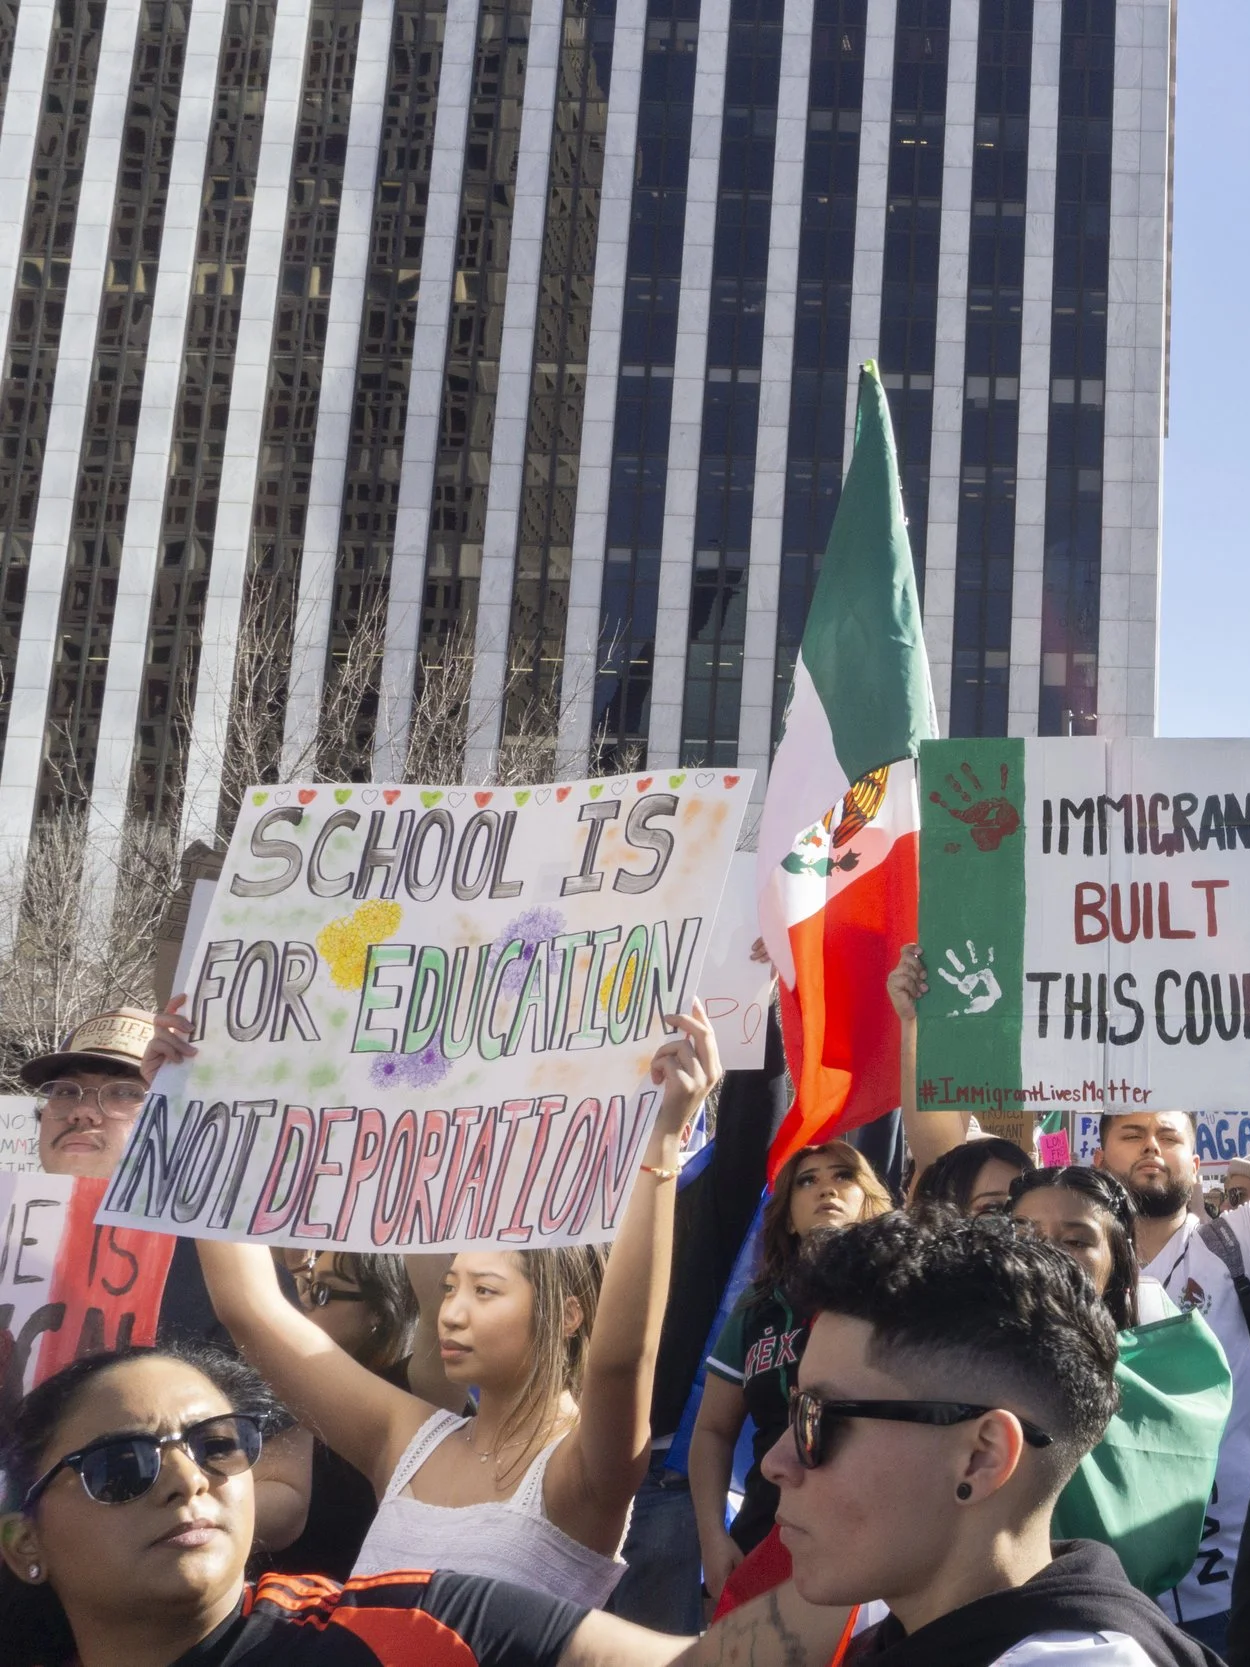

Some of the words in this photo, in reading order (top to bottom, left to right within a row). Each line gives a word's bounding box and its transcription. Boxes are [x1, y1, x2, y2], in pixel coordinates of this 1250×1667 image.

[230, 806, 524, 902] SCHOOL
[560, 793, 680, 897] IS
[1074, 879, 1230, 946] BUILT
[188, 938, 321, 1043] FOR
[350, 916, 702, 1061] EDUCATION
[1026, 970, 1145, 1047] THIS
[918, 1076, 1153, 1112] #ImmigrantLivesMatter
[104, 1092, 278, 1230] NOT
[246, 1090, 657, 1247] DEPORTATION
[87, 1223, 139, 1297] IS
